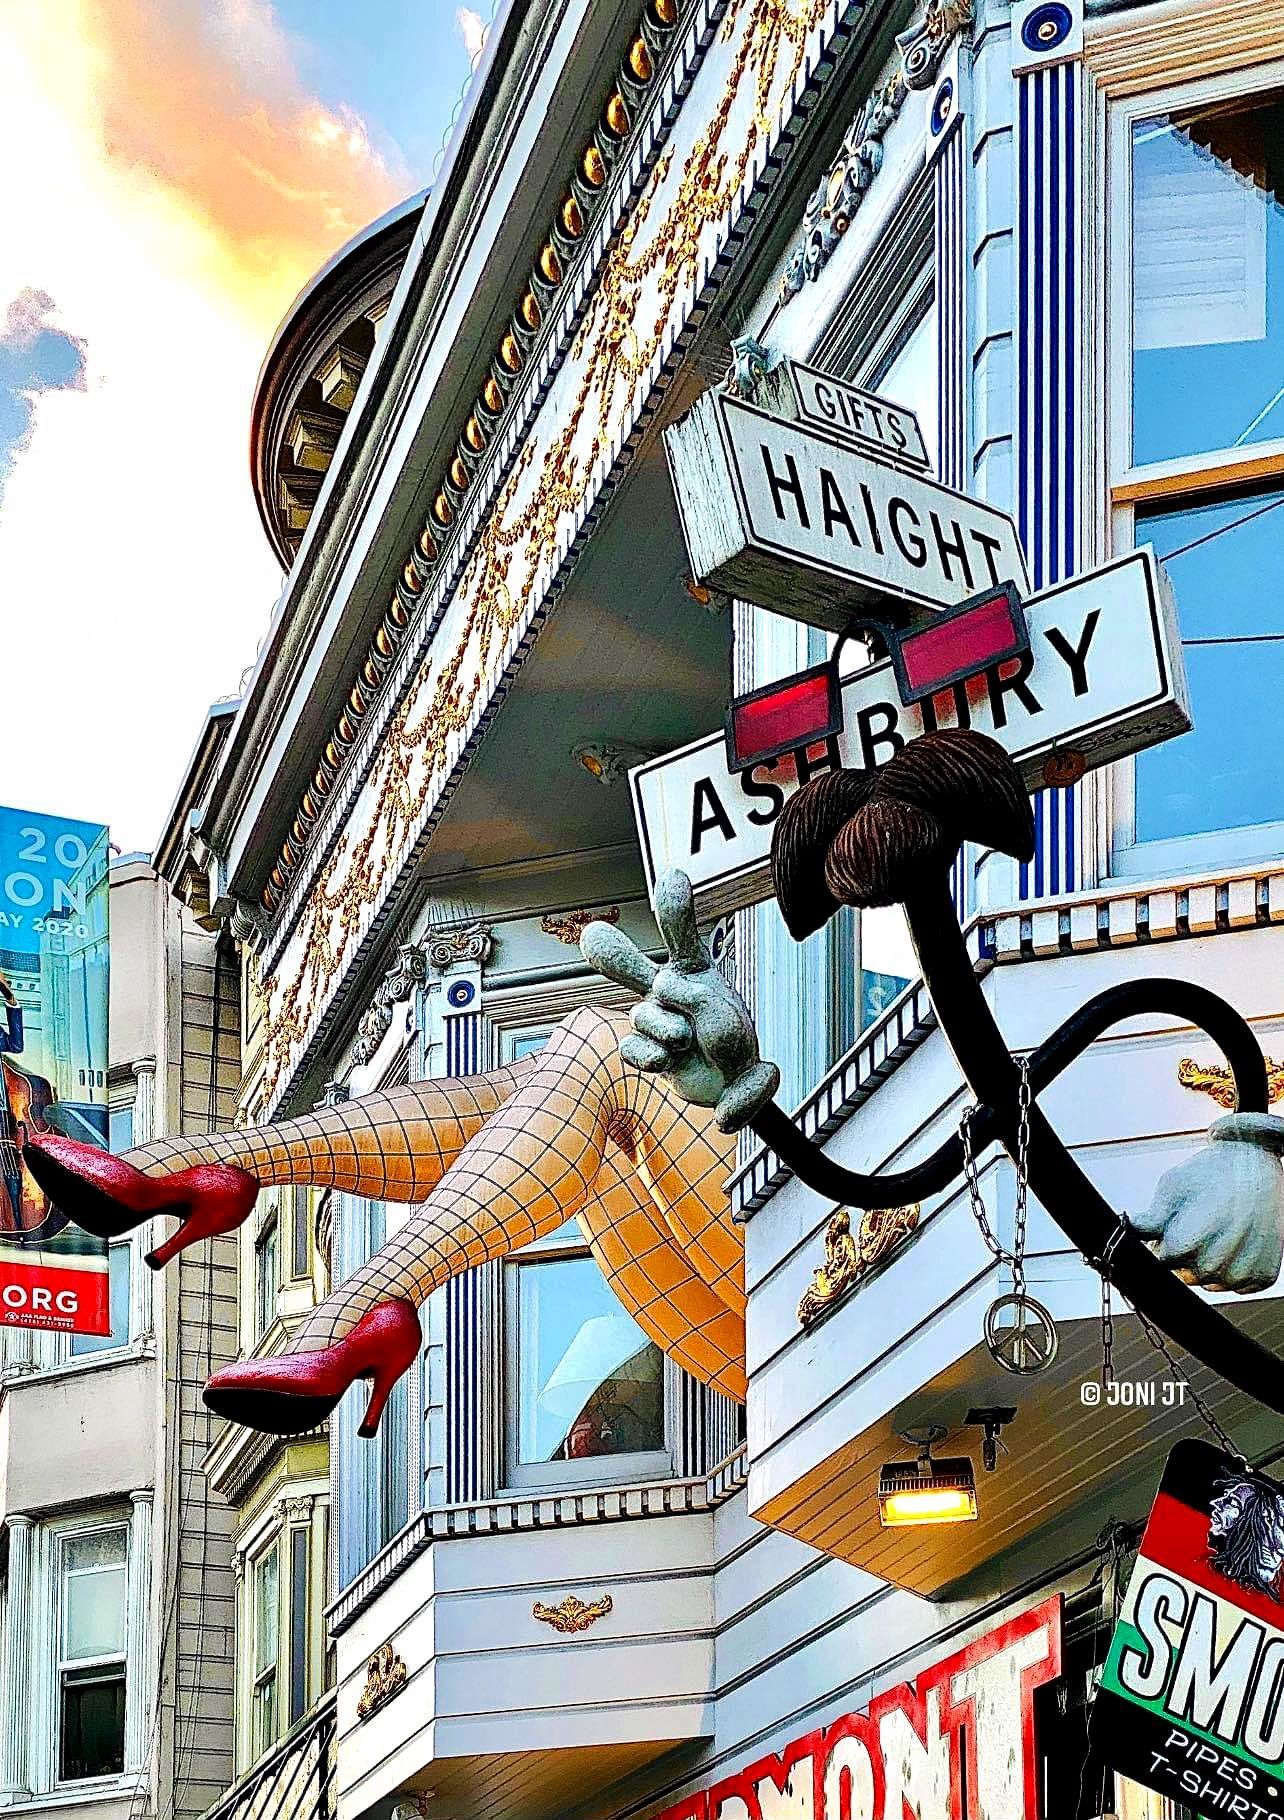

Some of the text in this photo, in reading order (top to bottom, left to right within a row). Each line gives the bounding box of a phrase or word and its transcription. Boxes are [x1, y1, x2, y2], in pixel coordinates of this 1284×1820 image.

[814, 381, 907, 449] GIFTS
[759, 443, 1002, 590] HAIGHT
[18, 826, 88, 869] 20
[32, 917, 89, 940] 2020
[2, 1284, 79, 1314] ORG
[1164, 1728, 1258, 1791] PIPES
